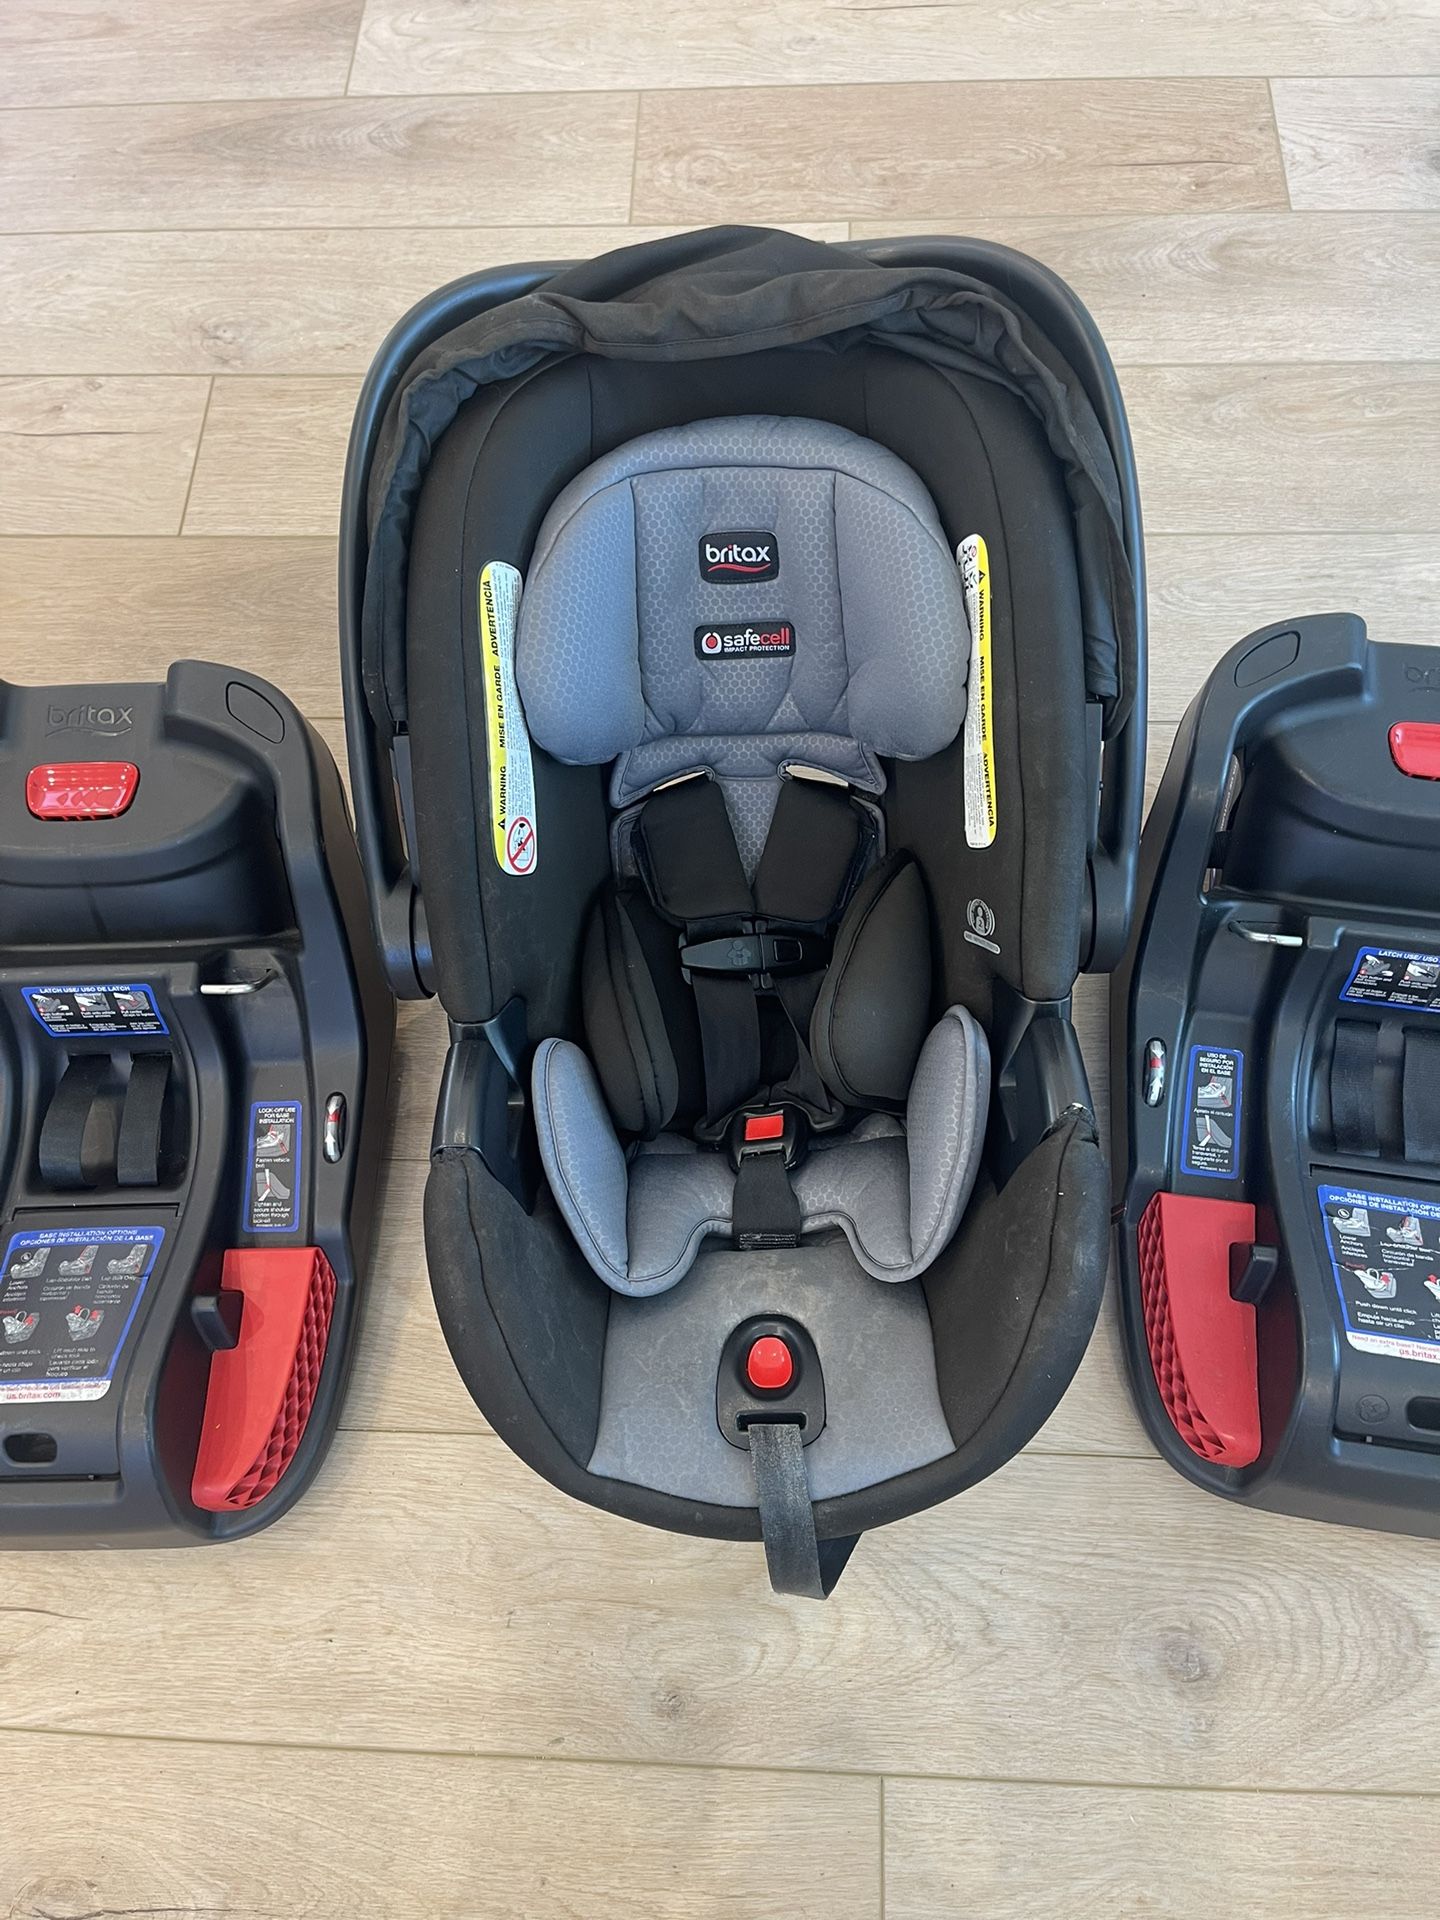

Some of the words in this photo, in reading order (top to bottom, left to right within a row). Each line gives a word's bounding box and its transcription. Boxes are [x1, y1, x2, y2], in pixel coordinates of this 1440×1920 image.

[705, 544, 770, 562] britax
[482, 580, 499, 656] ADVERTENCIA
[724, 628, 790, 646] safecell
[494, 665, 503, 702] GARDE
[47, 704, 133, 726] britax
[498, 704, 504, 720] EN
[980, 686, 986, 700] EN
[983, 752, 994, 827] ADVERTENCIA
[1329, 1195, 1367, 1206] OPCIONES
[1347, 1192, 1366, 1200] BASE
[1368, 1195, 1418, 1209] INSTALLATION
